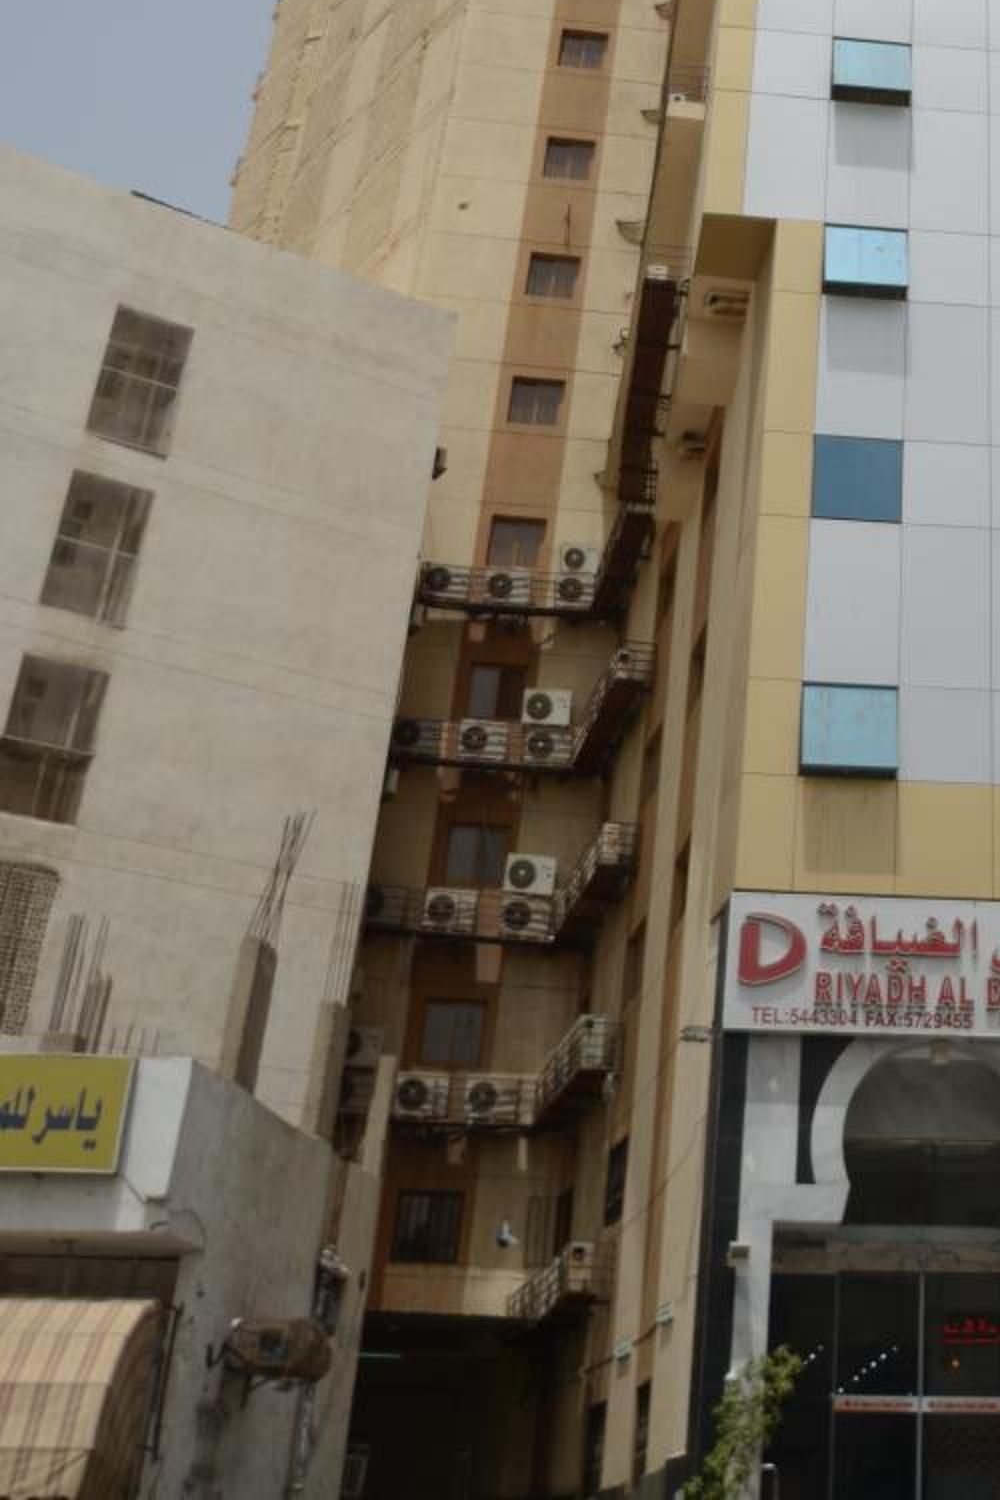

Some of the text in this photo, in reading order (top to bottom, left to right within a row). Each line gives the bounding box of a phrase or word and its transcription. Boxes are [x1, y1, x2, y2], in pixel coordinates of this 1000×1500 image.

[817, 902, 978, 973] الضيافة
[813, 971, 928, 1006] RIYADH
[936, 976, 975, 1010] AL
[32, 1087, 103, 1150] ياسر
